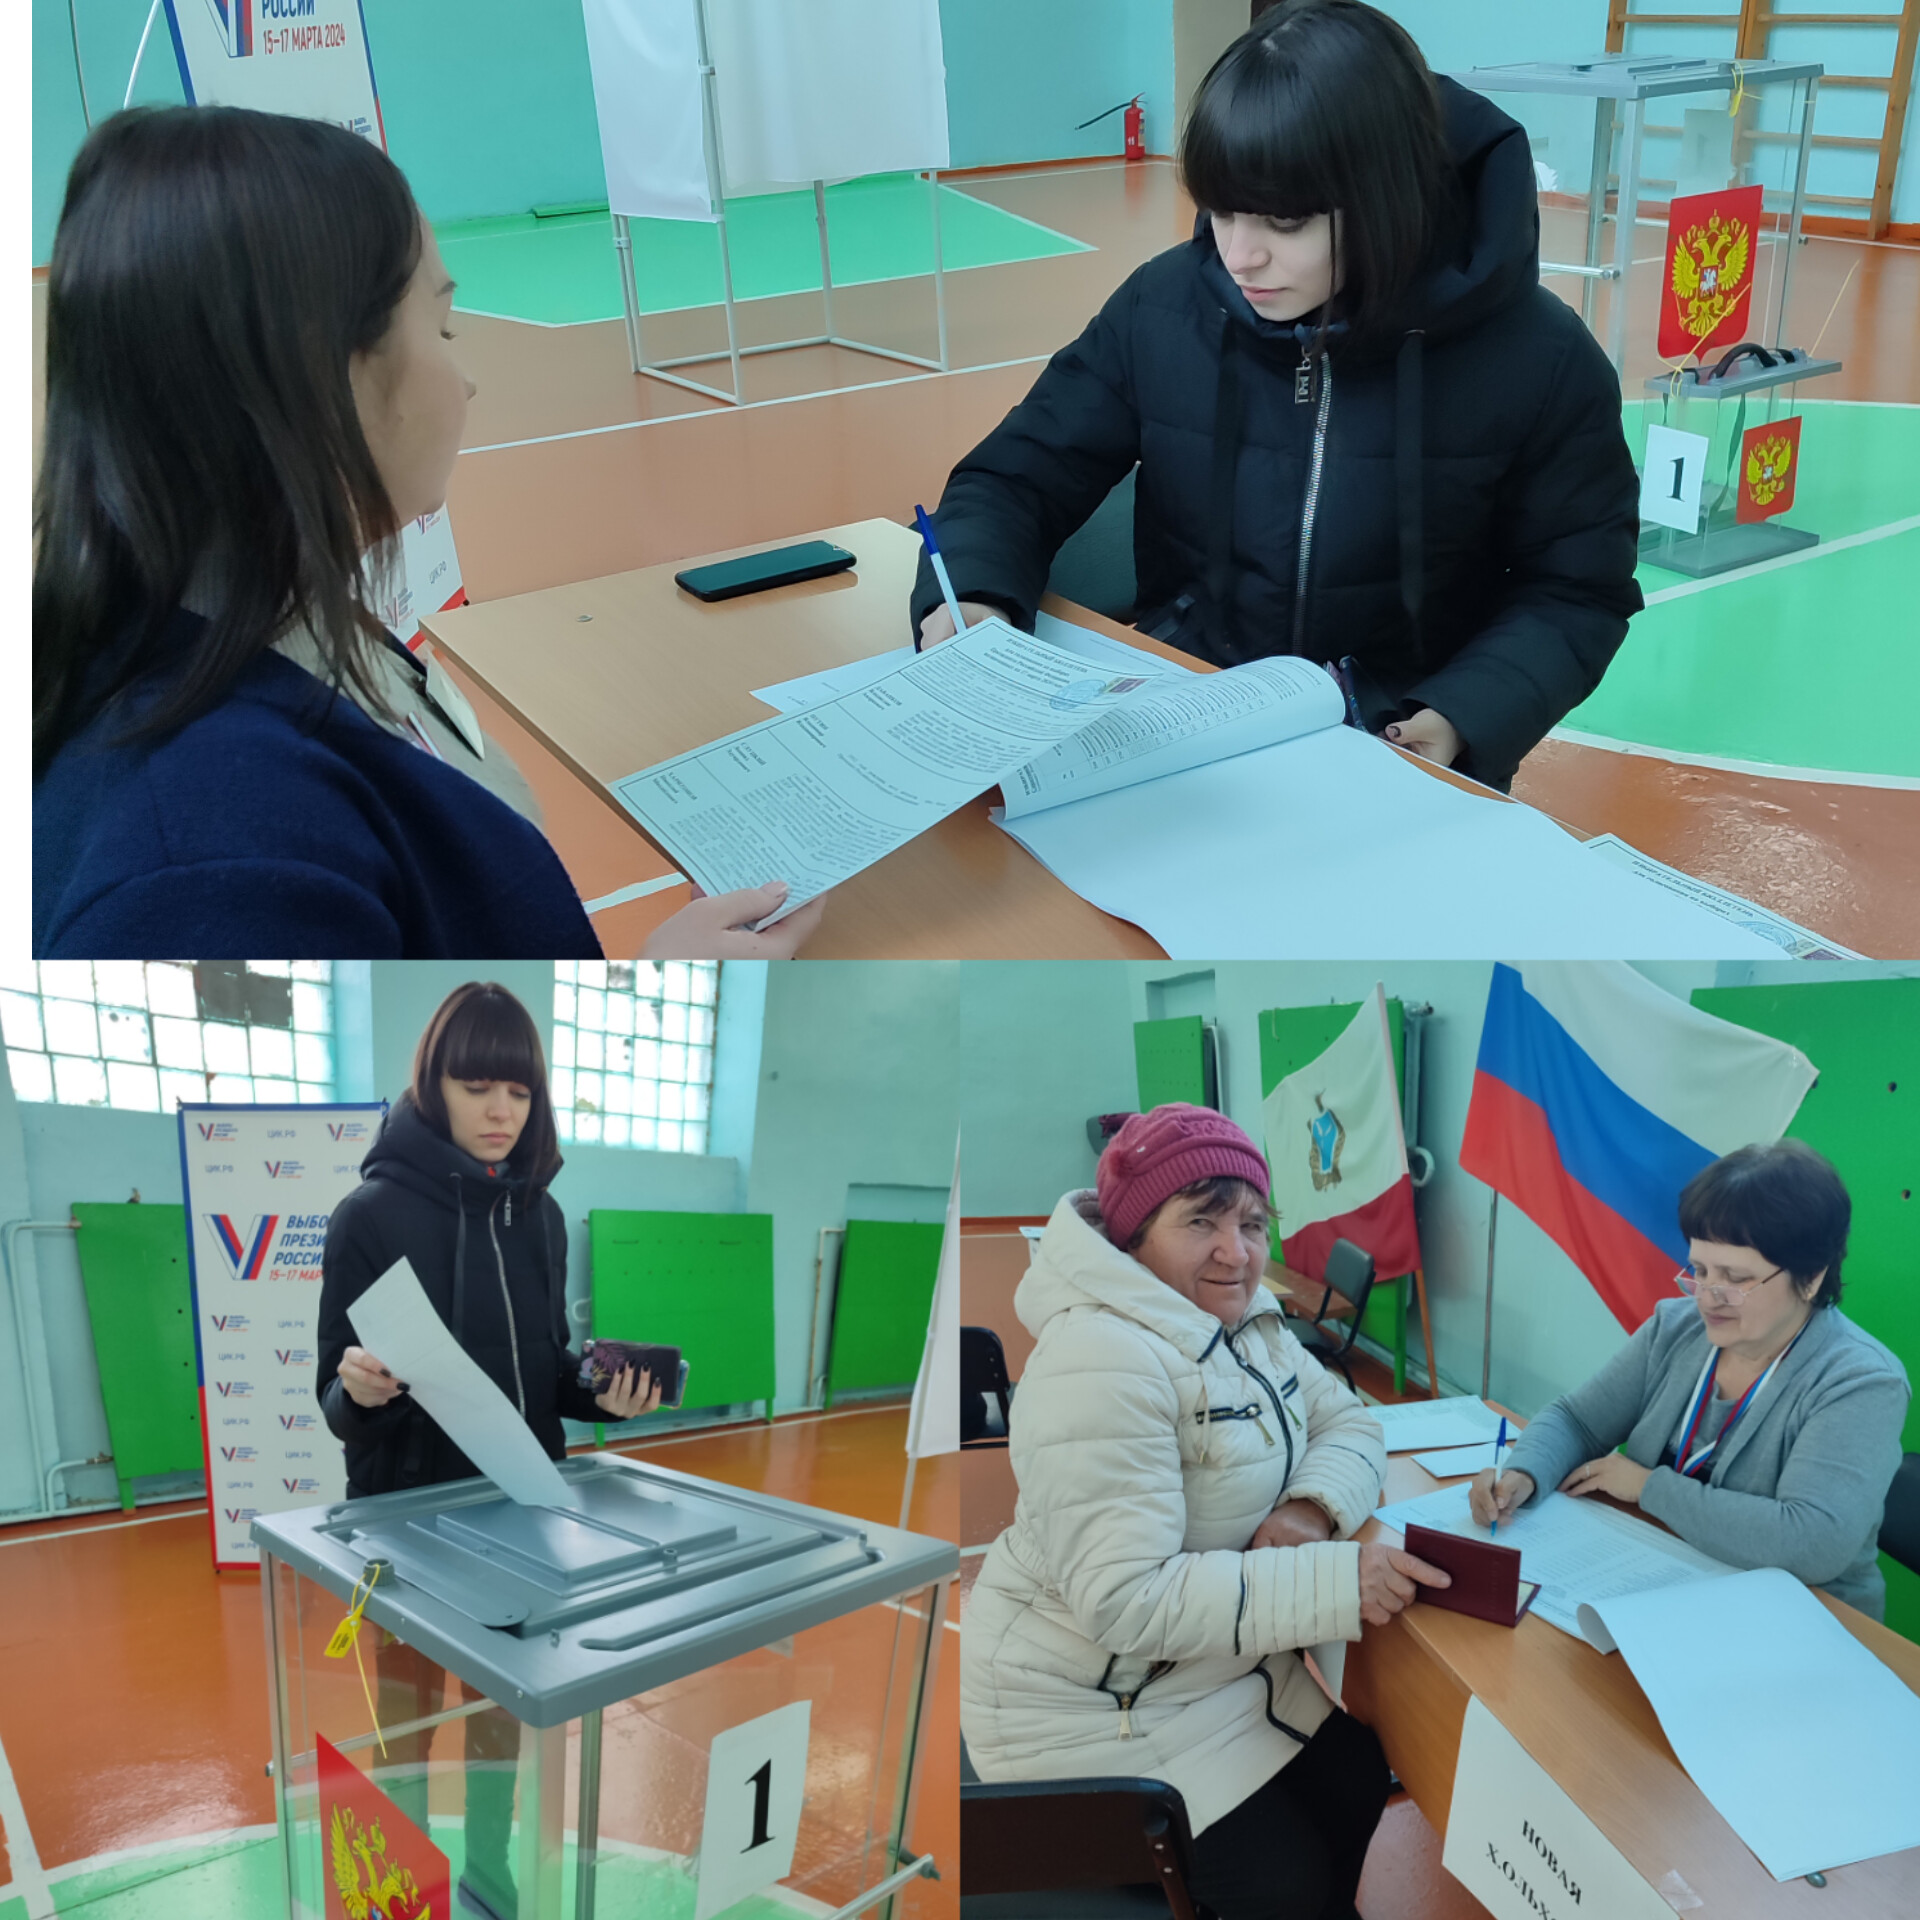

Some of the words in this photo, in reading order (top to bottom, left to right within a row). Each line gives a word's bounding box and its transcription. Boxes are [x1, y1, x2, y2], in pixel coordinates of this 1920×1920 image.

[291, 25, 323, 52] МАРТА
[325, 23, 346, 48] 2024
[1666, 457, 1686, 503] 1
[267, 1129, 296, 1138] ЦИК.РФ
[333, 1165, 361, 1173] ЦИК.Р
[286, 1214, 329, 1229] ВЫБО
[279, 1233, 327, 1247] ПРЕЗИ
[273, 1251, 324, 1266] РОССИ
[298, 1269, 323, 1281] МАР
[740, 1758, 776, 1854] 1
[1522, 1819, 1581, 1906] НОВАЯ
[1486, 1841, 1557, 1920] ХОЛЬХ
